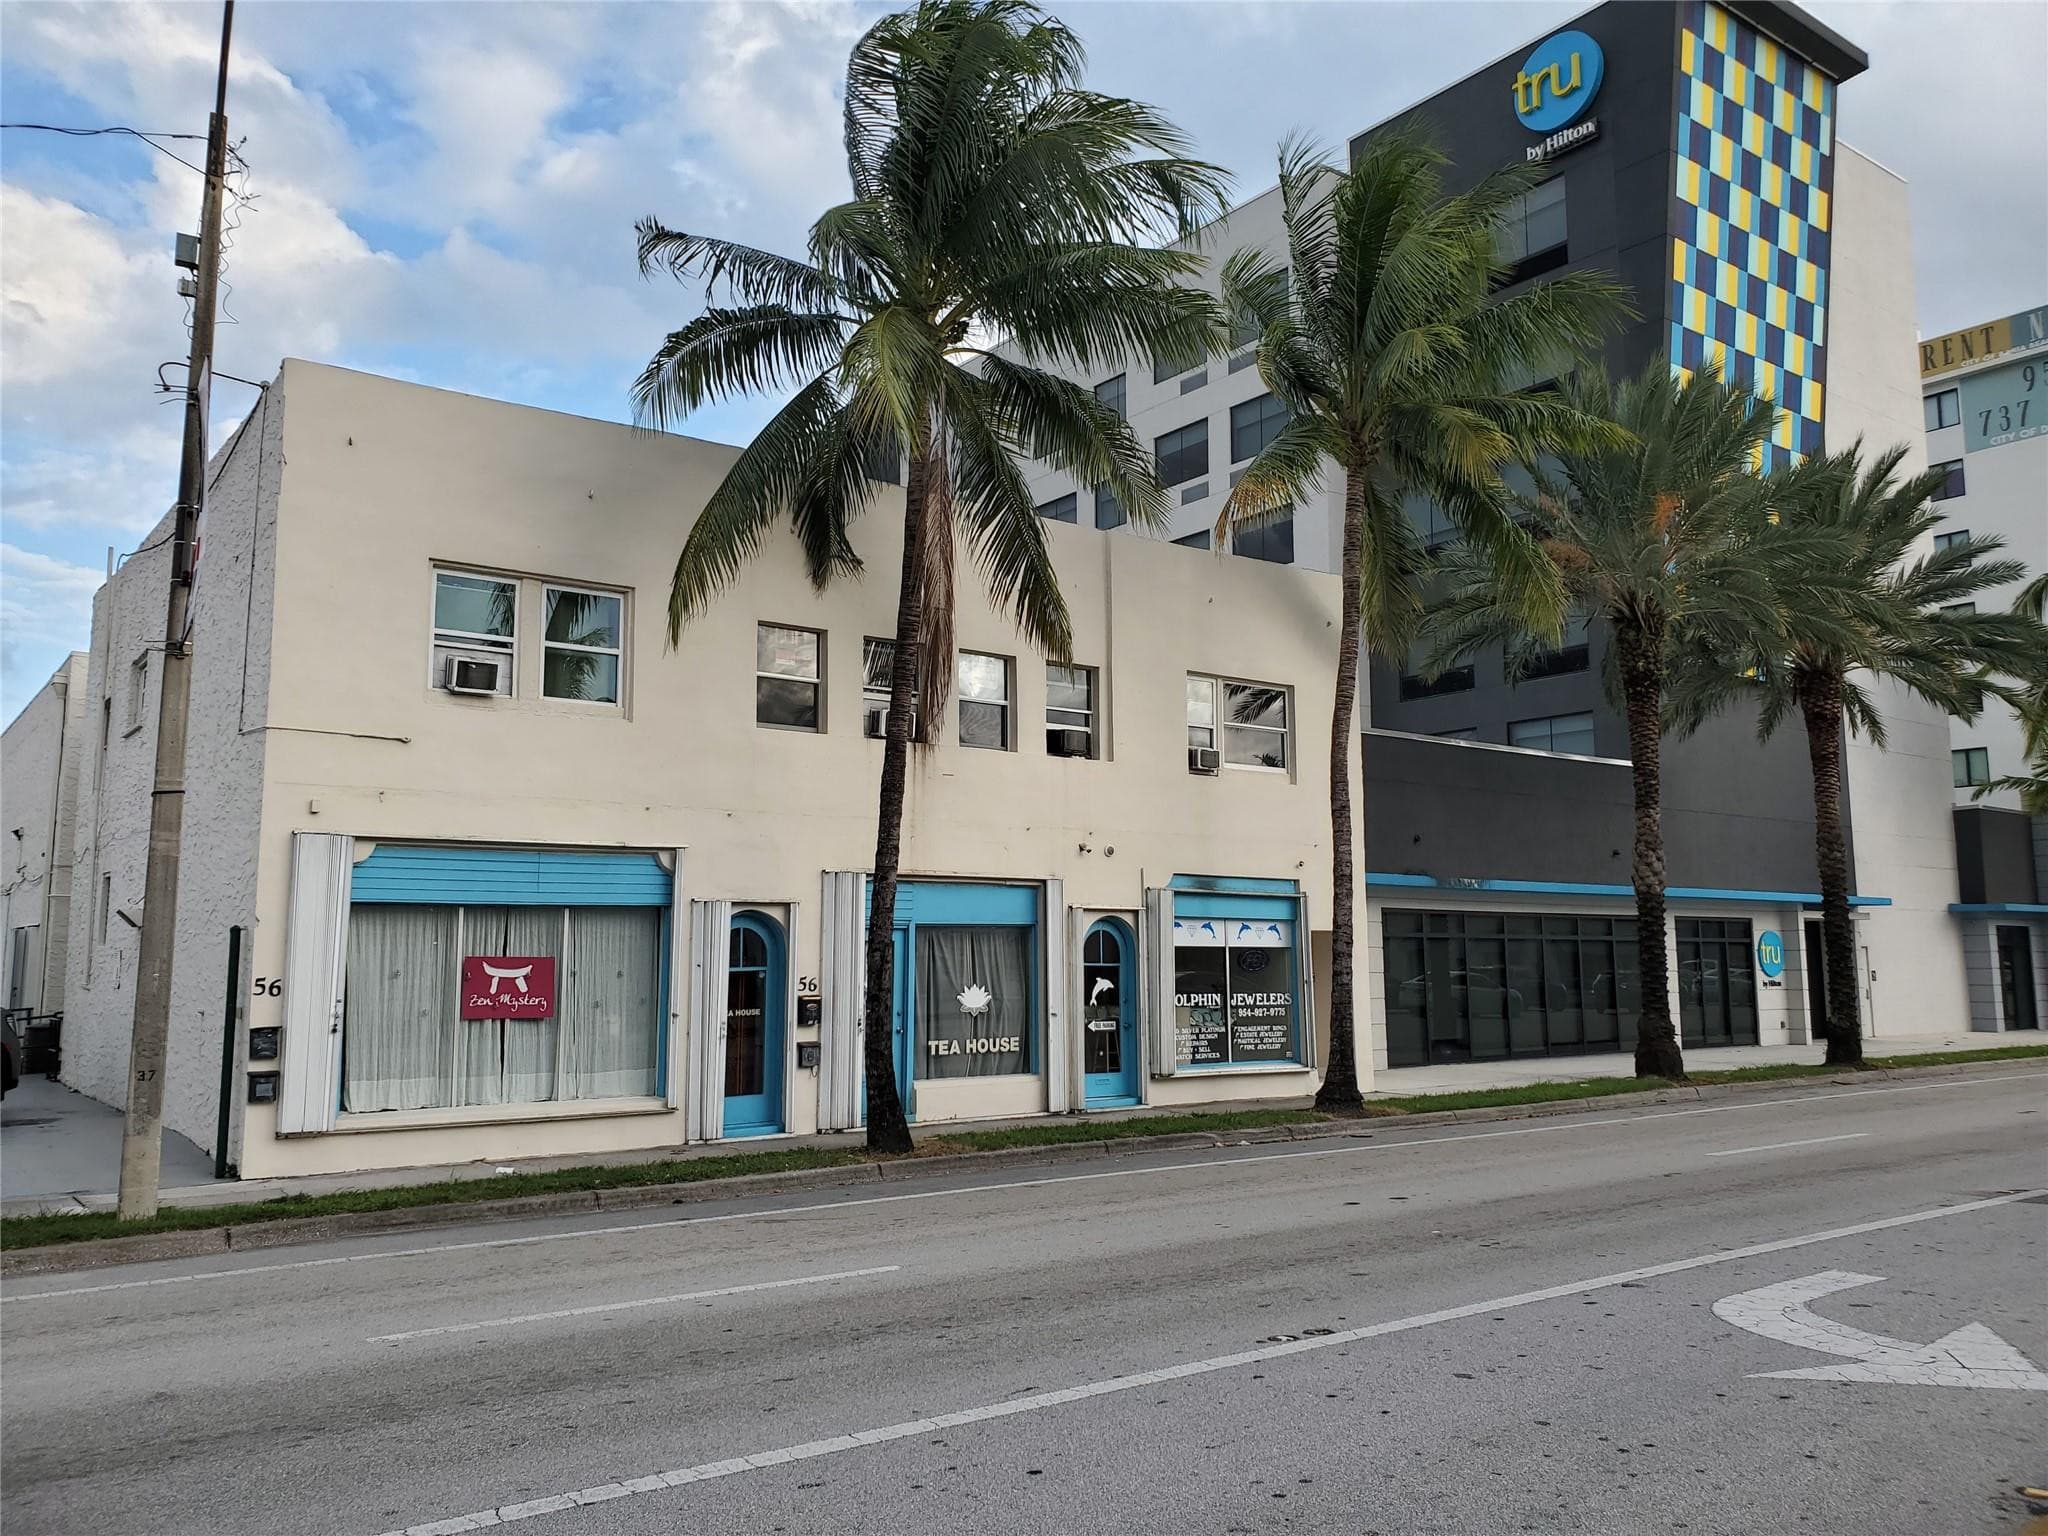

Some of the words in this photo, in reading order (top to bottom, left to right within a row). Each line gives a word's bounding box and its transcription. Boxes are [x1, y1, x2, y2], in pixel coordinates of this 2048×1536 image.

[1512, 52, 1581, 114] tru
[1526, 145, 1545, 161] by
[1546, 121, 1596, 152] Hilton
[1922, 326, 1994, 372] RENT
[1979, 399, 2030, 437] 737
[1991, 432, 2015, 446] CITY
[2019, 427, 2037, 438] OF
[1760, 940, 1780, 964] tru
[253, 977, 282, 997] 56
[798, 976, 817, 992] 56
[469, 994, 493, 1007] Zen
[499, 993, 547, 1012] Mystery
[1231, 993, 1292, 1006] JEWELERS
[736, 1008, 761, 1017] HOUSE
[928, 1039, 960, 1056] TEA
[965, 1036, 1020, 1054] HOUSE
[137, 1069, 157, 1082] 37
